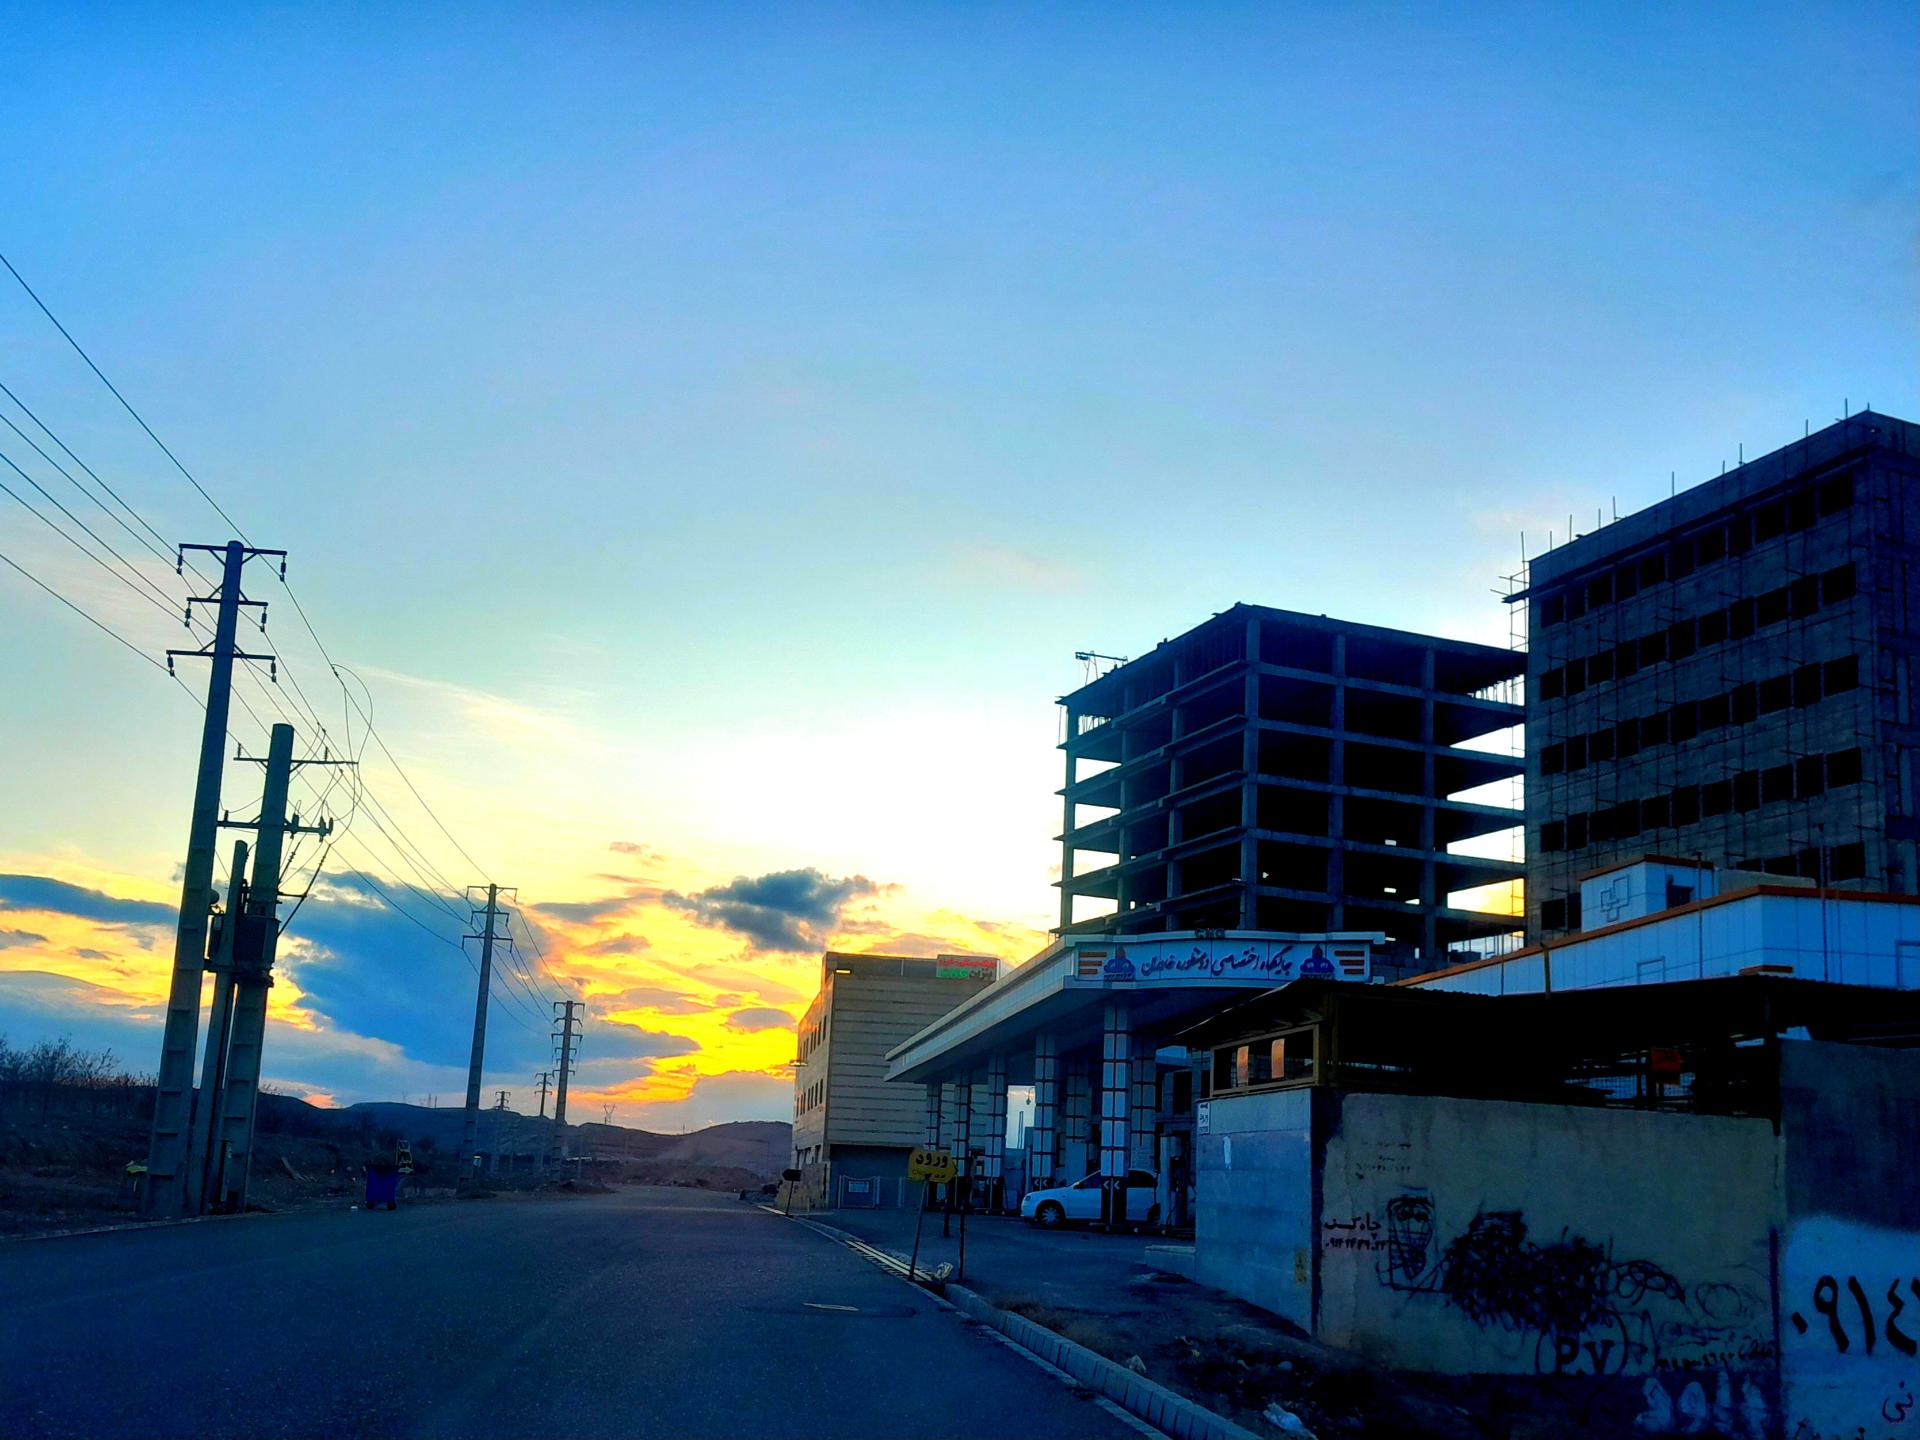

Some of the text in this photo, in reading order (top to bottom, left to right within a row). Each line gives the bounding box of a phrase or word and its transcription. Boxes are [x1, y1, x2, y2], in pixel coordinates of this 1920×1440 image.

[1212, 947, 1259, 976] اختصاصی
[1260, 946, 1293, 976] جایگاه
[916, 1153, 948, 1168] ورود
[1791, 1275, 1920, 1356] ٠٩١٤
